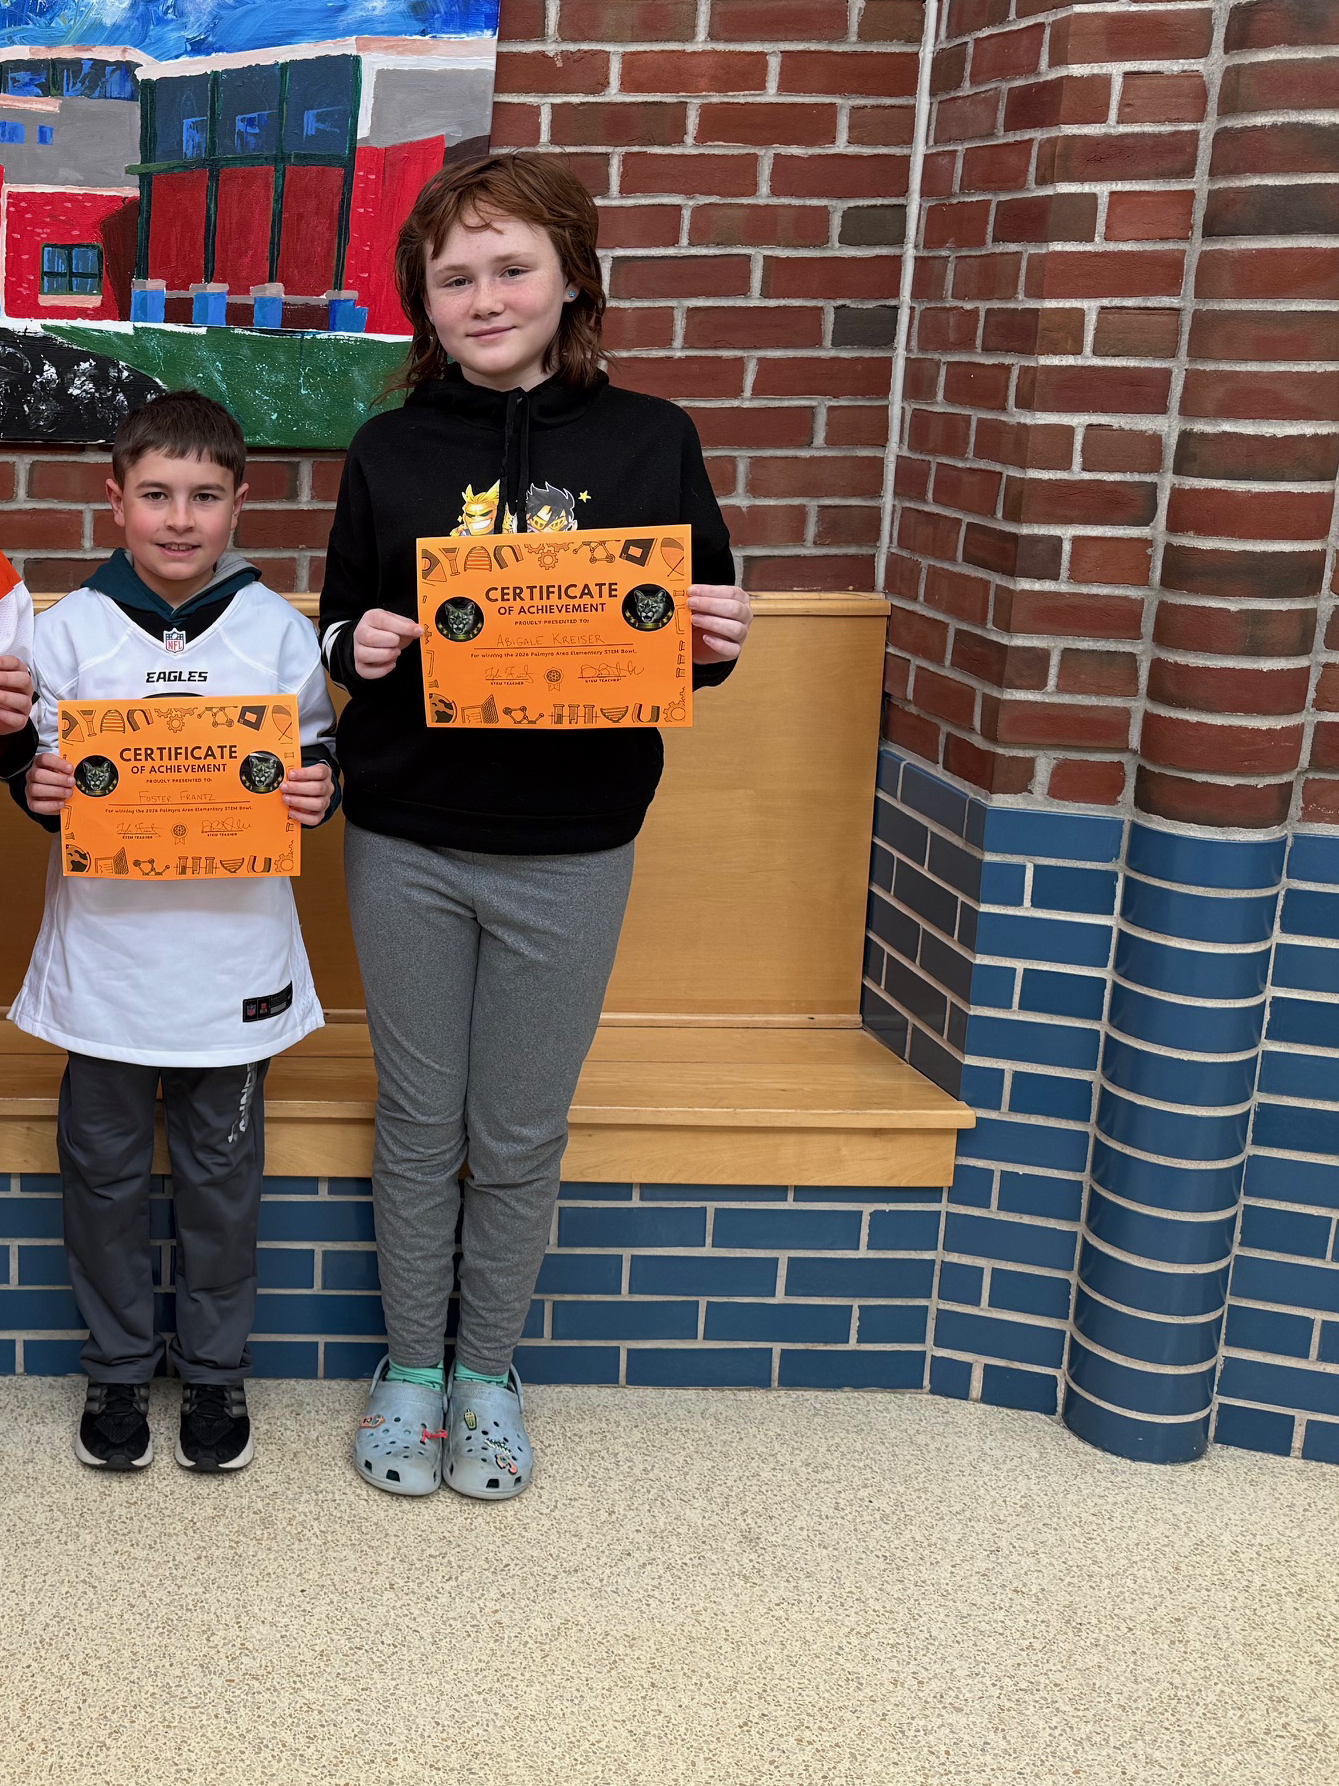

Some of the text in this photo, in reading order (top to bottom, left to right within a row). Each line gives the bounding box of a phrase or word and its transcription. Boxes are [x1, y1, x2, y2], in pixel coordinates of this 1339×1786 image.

[485, 582, 618, 603] CERTIFICATE
[497, 602, 607, 616] OF ACHIEVEMENT
[167, 640, 183, 650] NFL
[552, 633, 606, 646] KREISER
[145, 670, 209, 684] EAGLES
[119, 744, 238, 763] CERTIFICATE
[131, 764, 228, 775] OF ACHIEVEMENT
